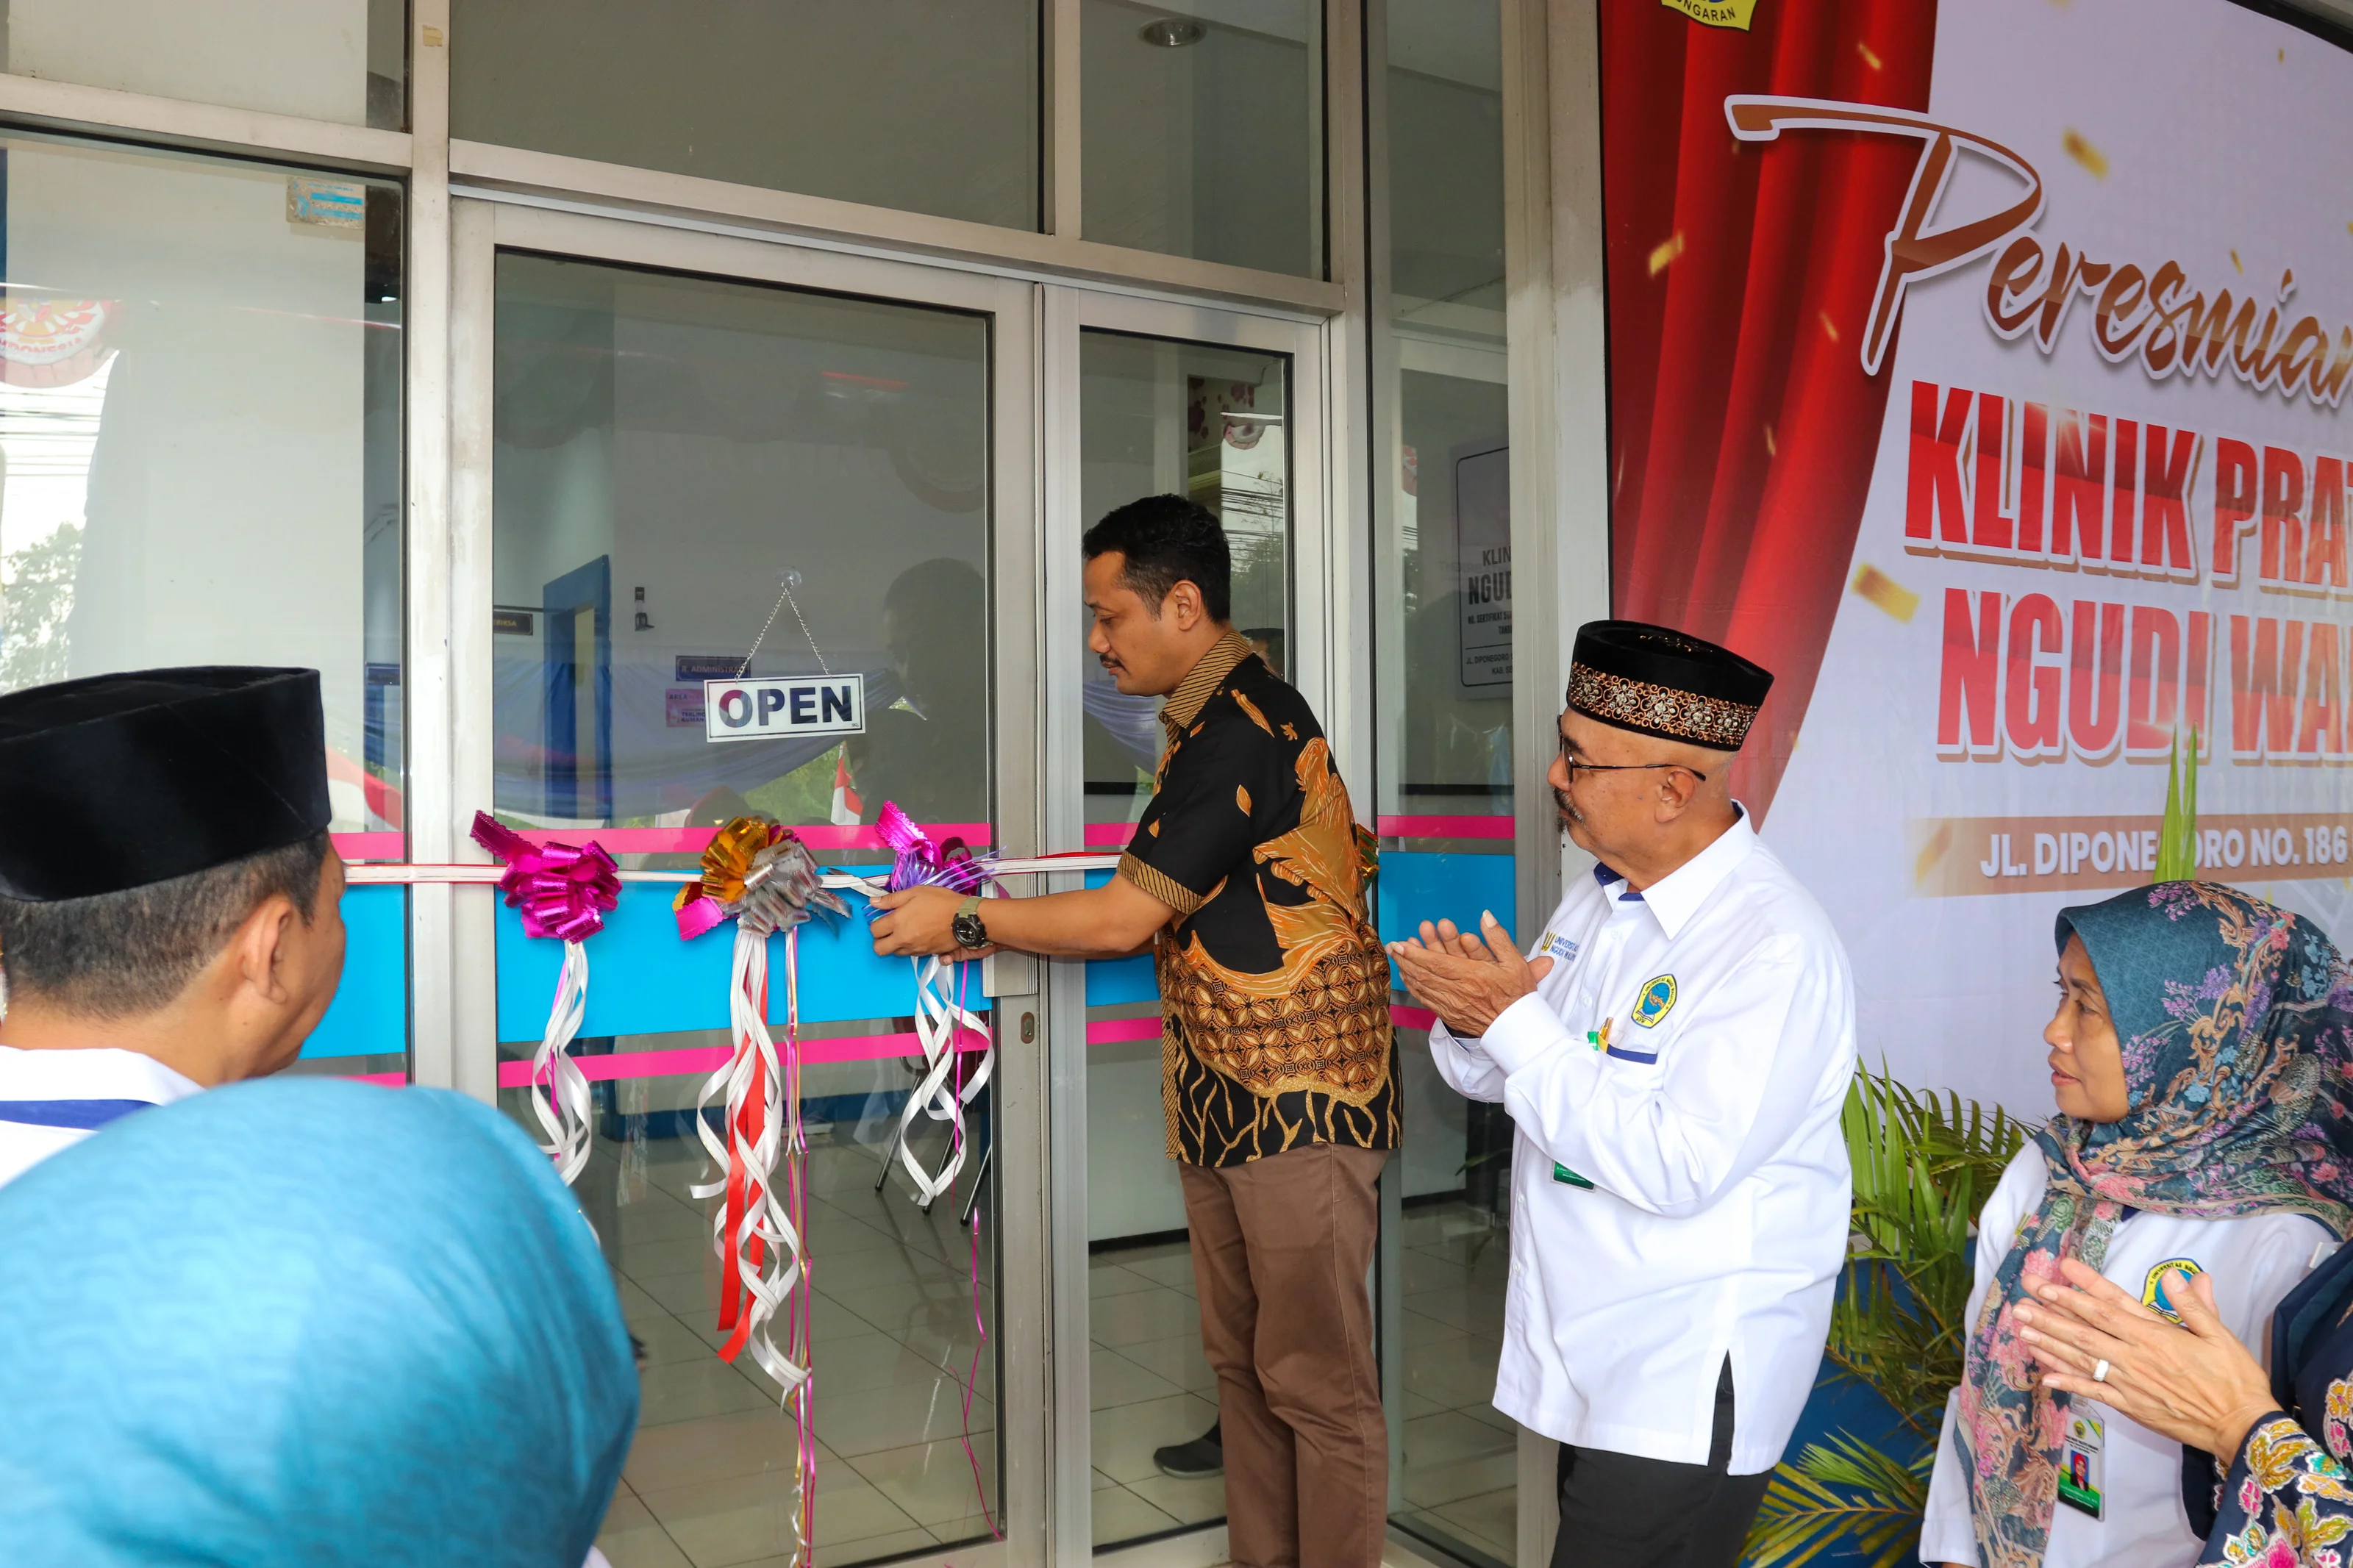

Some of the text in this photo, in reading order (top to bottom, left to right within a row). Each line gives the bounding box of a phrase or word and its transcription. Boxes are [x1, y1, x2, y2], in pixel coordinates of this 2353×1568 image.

[1677, 0, 1736, 21] NGARAN
[1904, 379, 2353, 588] KLINIK PRA
[1937, 587, 2353, 754] NGUDI WA
[718, 685, 852, 728] OPEN
[1980, 825, 2348, 878] JL. DIPONERO NO. 186
